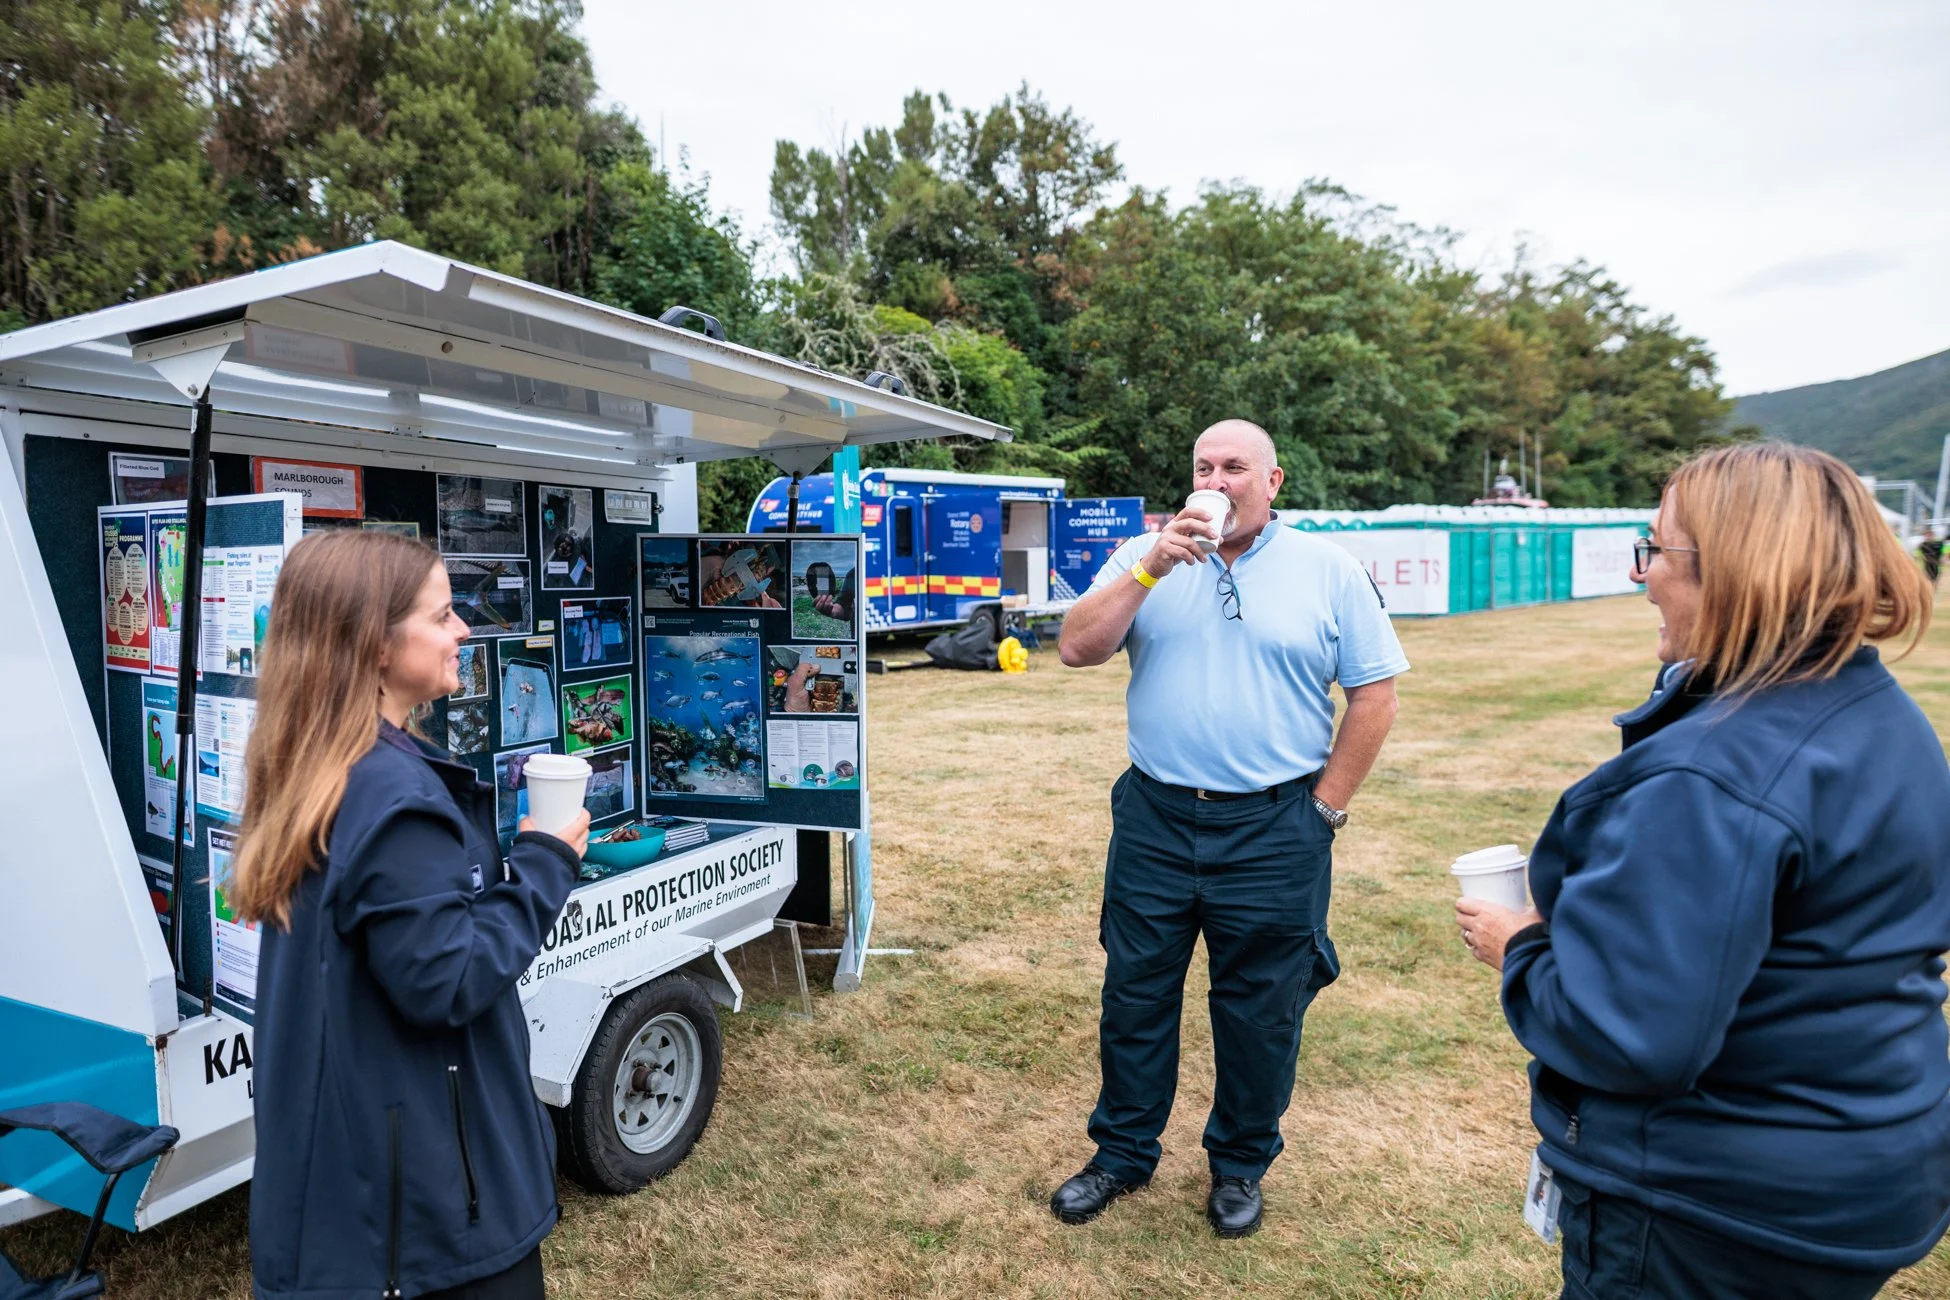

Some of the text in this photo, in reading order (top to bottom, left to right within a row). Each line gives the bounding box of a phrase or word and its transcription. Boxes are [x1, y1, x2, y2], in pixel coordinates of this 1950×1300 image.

[274, 472, 344, 485] MARLBOROUGH
[1080, 507, 1116, 517] MOBILE
[1068, 517, 1129, 527] COMMUNITY
[1087, 527, 1109, 537] HUB
[1360, 559, 1441, 586] LETS
[689, 630, 760, 638] Popular Recreational Fish
[535, 838, 784, 957] OASAL PROTECTION SOCIETY
[520, 873, 771, 987] & Enhancement of our Marine Enviroment
